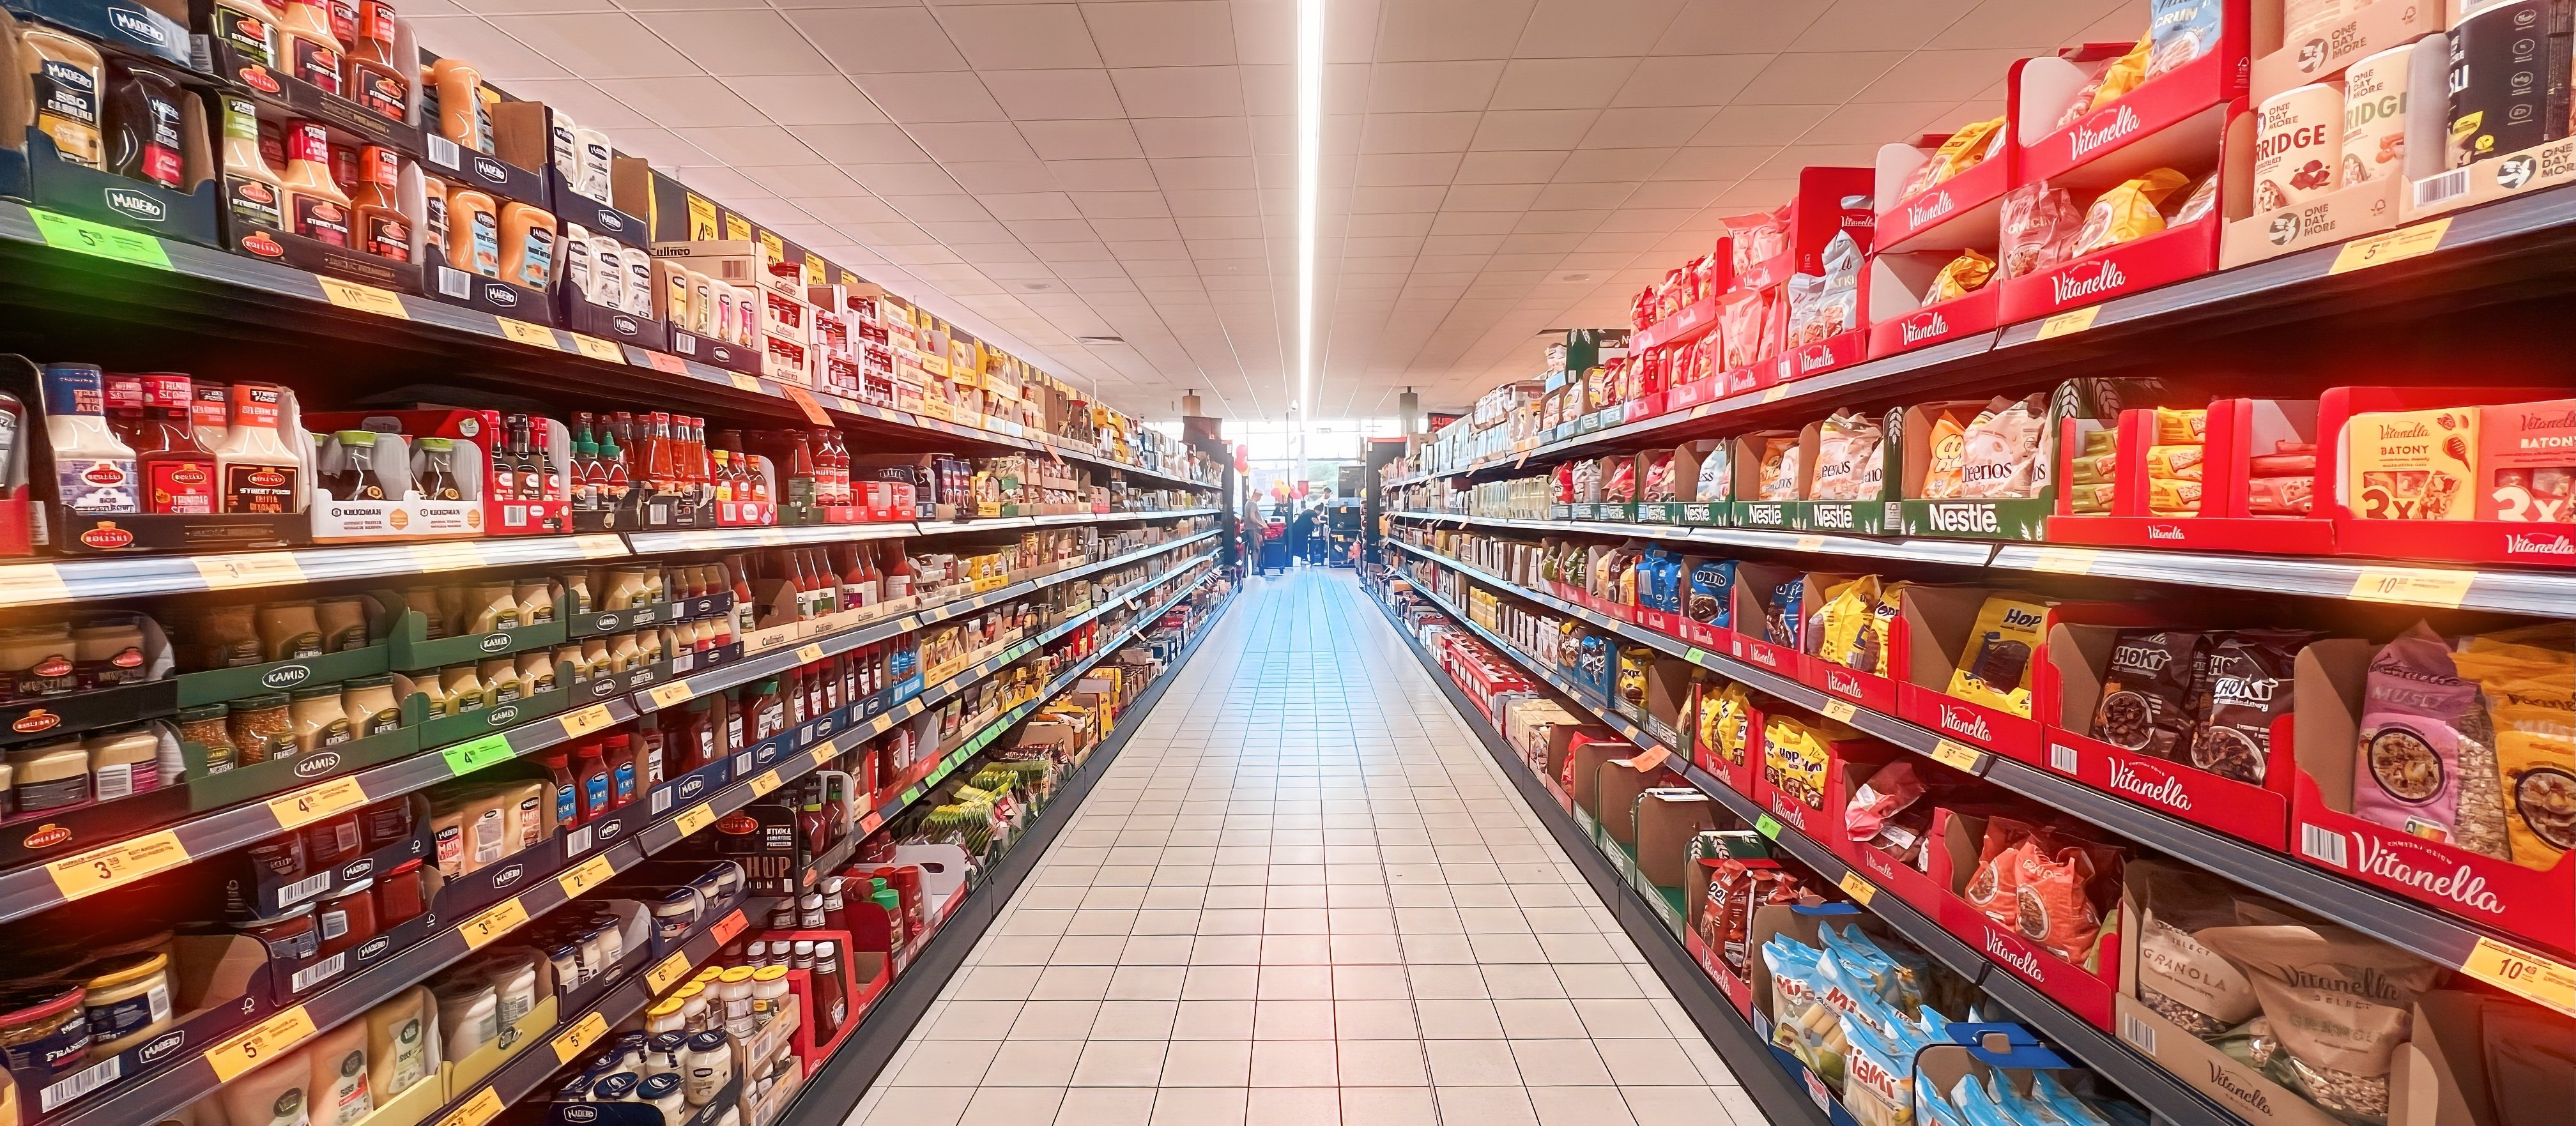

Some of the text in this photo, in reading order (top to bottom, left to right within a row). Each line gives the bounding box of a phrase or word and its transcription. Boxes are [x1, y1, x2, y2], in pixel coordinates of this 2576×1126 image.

[116, 13, 164, 43] MADERO
[2331, 21, 2357, 40] ONE
[2332, 34, 2354, 49] DAY
[2332, 36, 2367, 60] MORE
[2354, 68, 2374, 83] ONE
[2352, 82, 2384, 100] MORE
[2069, 105, 2140, 160] Vitanella
[2268, 115, 2299, 130] MORE
[2542, 142, 2573, 158] ONE
[2541, 162, 2576, 179] MOR
[2542, 153, 2571, 169] DAY
[111, 194, 160, 216] MADERO
[1908, 190, 1954, 231] Vitanella
[2304, 203, 2329, 217] ONE
[2304, 213, 2327, 227] DAY
[2304, 220, 2336, 237] MORE
[2051, 259, 2126, 305] Vitanella
[1901, 312, 1949, 346] Vitanella
[2379, 423, 2430, 440] Vitanella
[2380, 445, 2430, 455] BATONY
[2506, 534, 2575, 555] Vitanella
[268, 669, 305, 683] KAMIS
[1940, 704, 1991, 742] Vitanella
[300, 756, 335, 772] KAMIS
[2108, 756, 2192, 810] Vitanella
[2351, 831, 2506, 915] Vitanella
[1983, 925, 2044, 983] Vitanella
[2143, 948, 2227, 993] GRANOLA
[2277, 964, 2399, 1000] Vitanella
[2208, 1060, 2274, 1116] Vitanella
